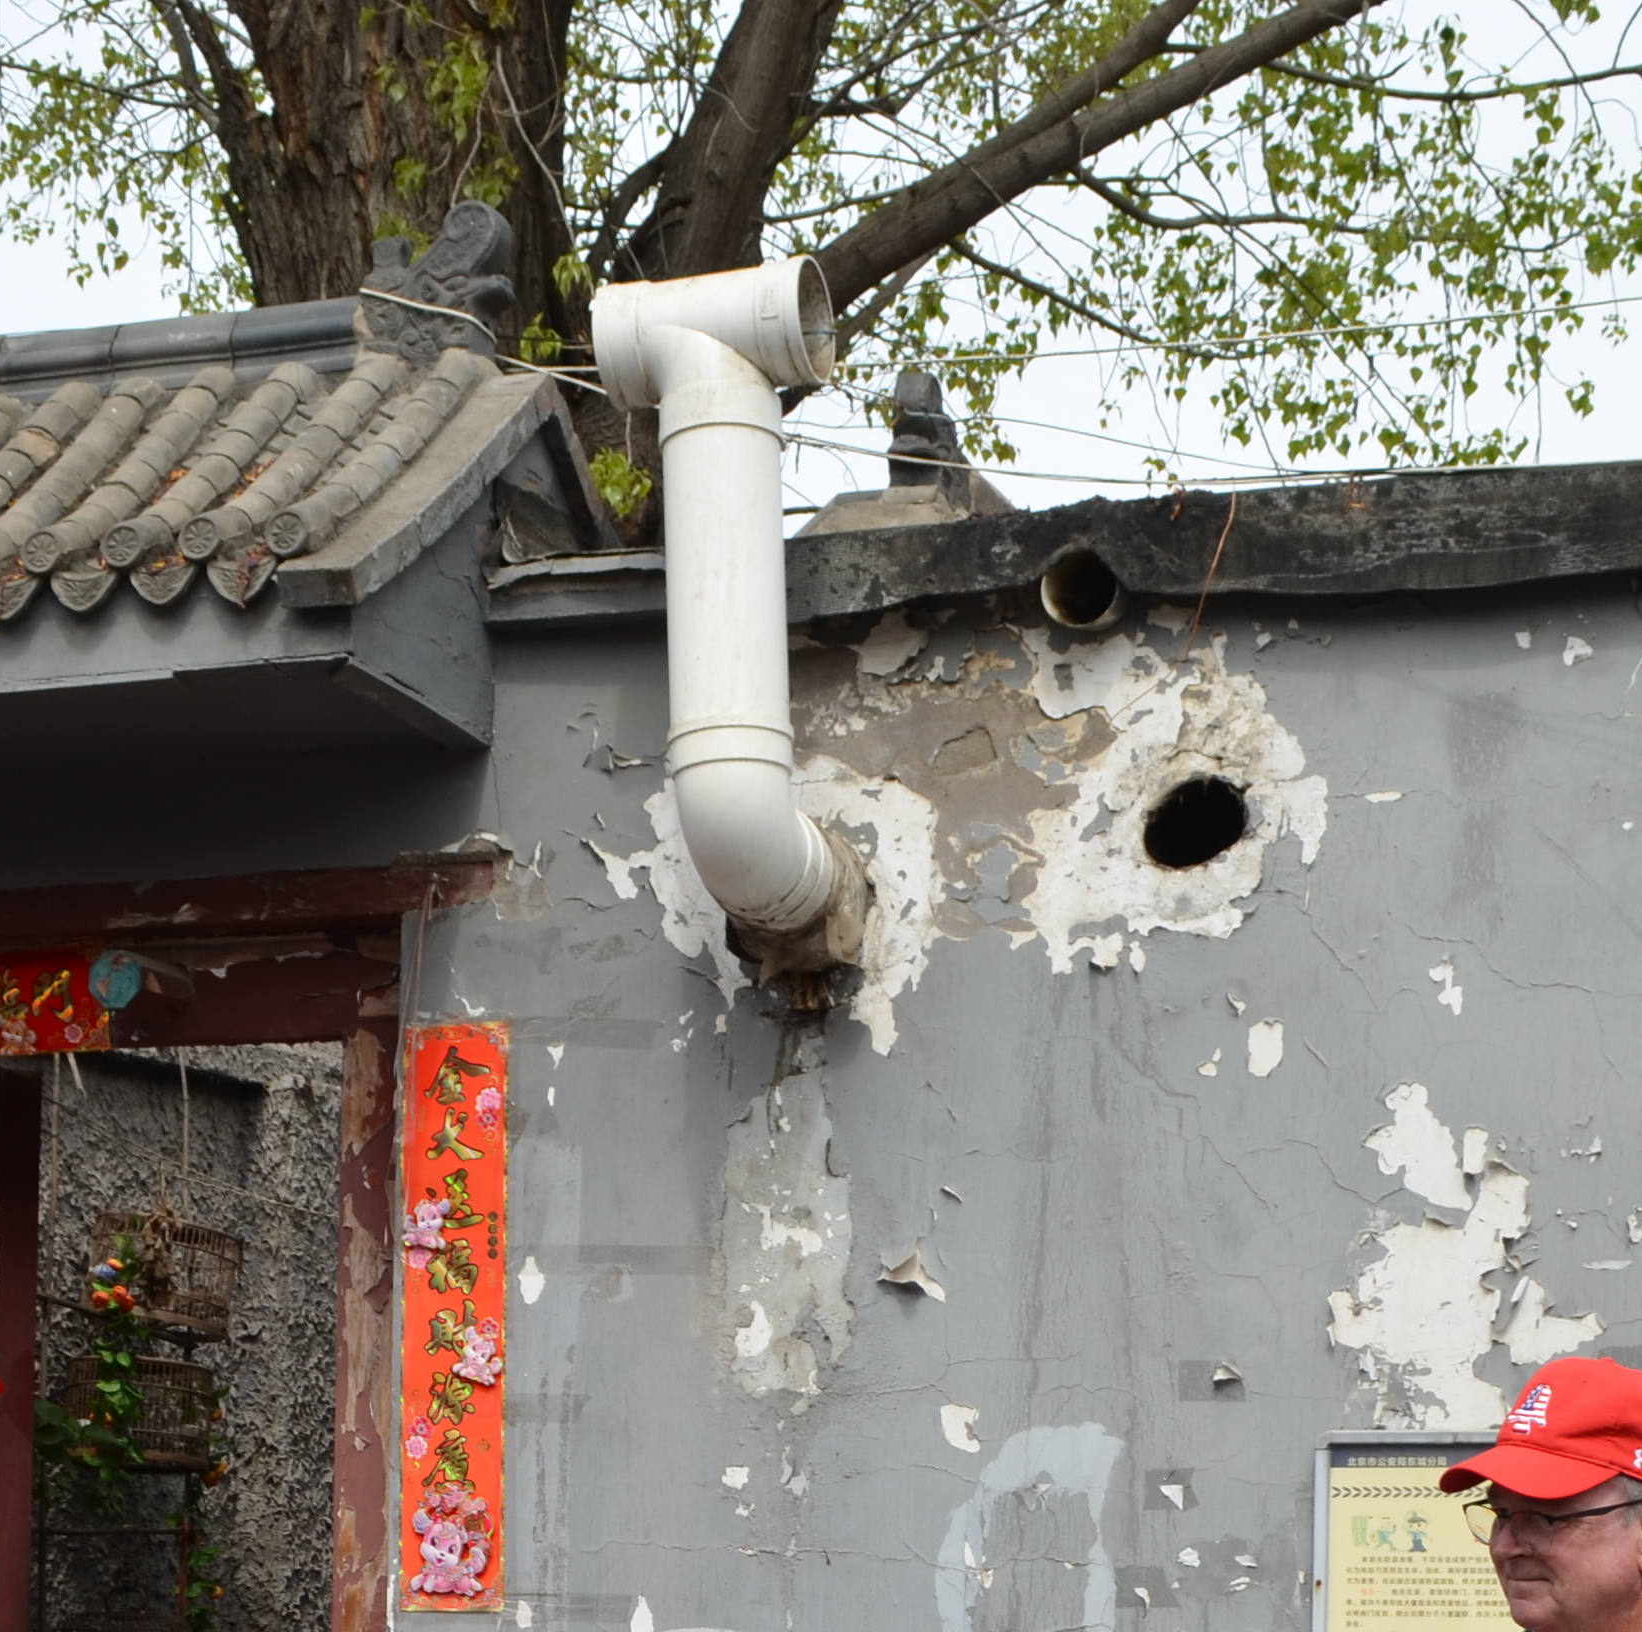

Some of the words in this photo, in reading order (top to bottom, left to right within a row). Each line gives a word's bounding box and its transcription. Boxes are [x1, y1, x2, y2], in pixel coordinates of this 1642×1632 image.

[1347, 1456, 1448, 1467] 北京市公安局东城分局
